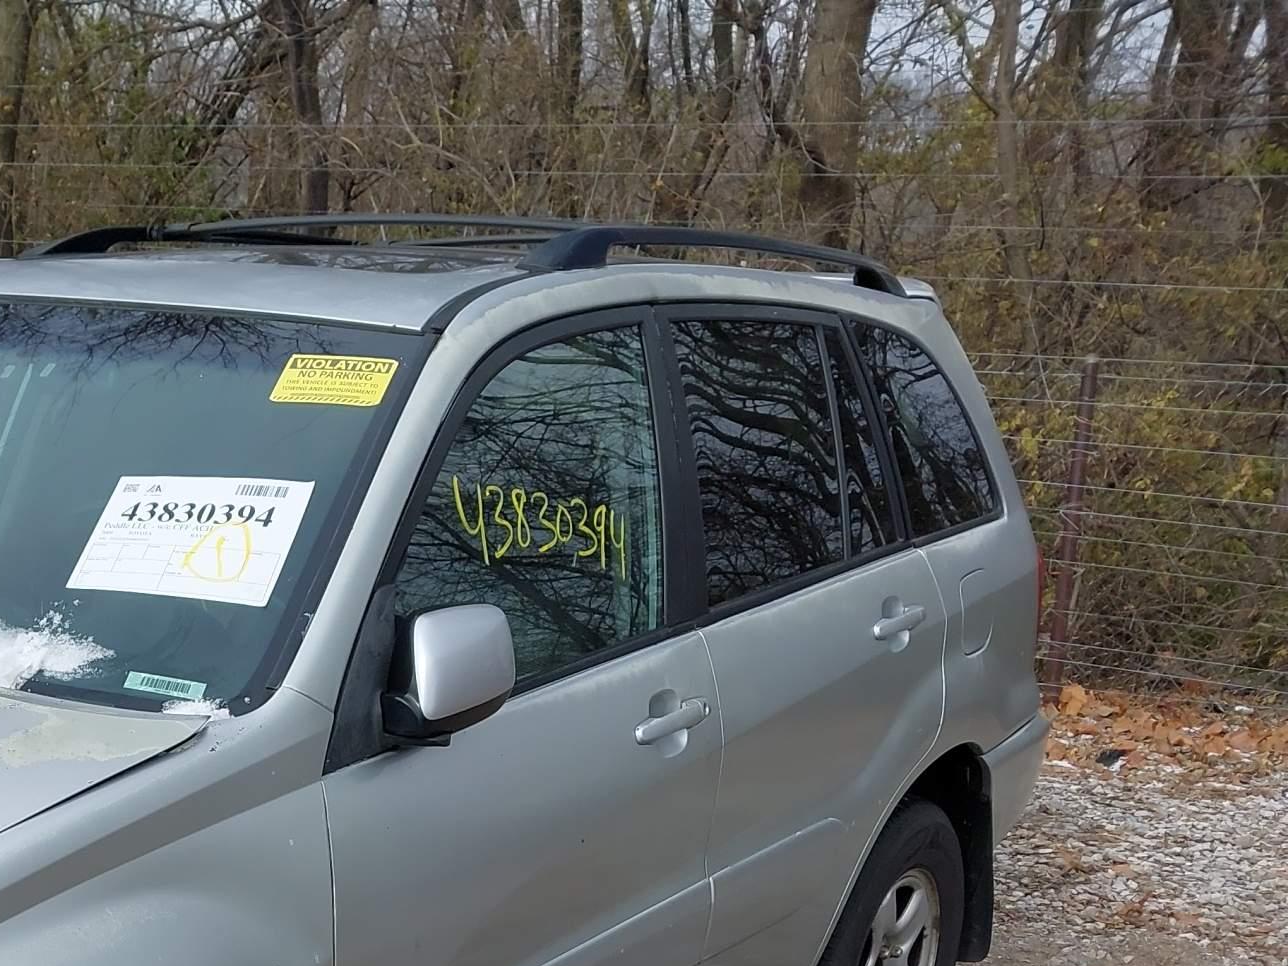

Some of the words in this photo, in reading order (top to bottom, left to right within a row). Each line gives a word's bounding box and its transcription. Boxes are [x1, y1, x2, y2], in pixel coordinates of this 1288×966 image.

[295, 359, 390, 372] VIOLATION
[297, 370, 318, 378] NO
[319, 371, 374, 381] PARKING
[121, 501, 276, 527] 43830394
[452, 474, 626, 581] 43830394
